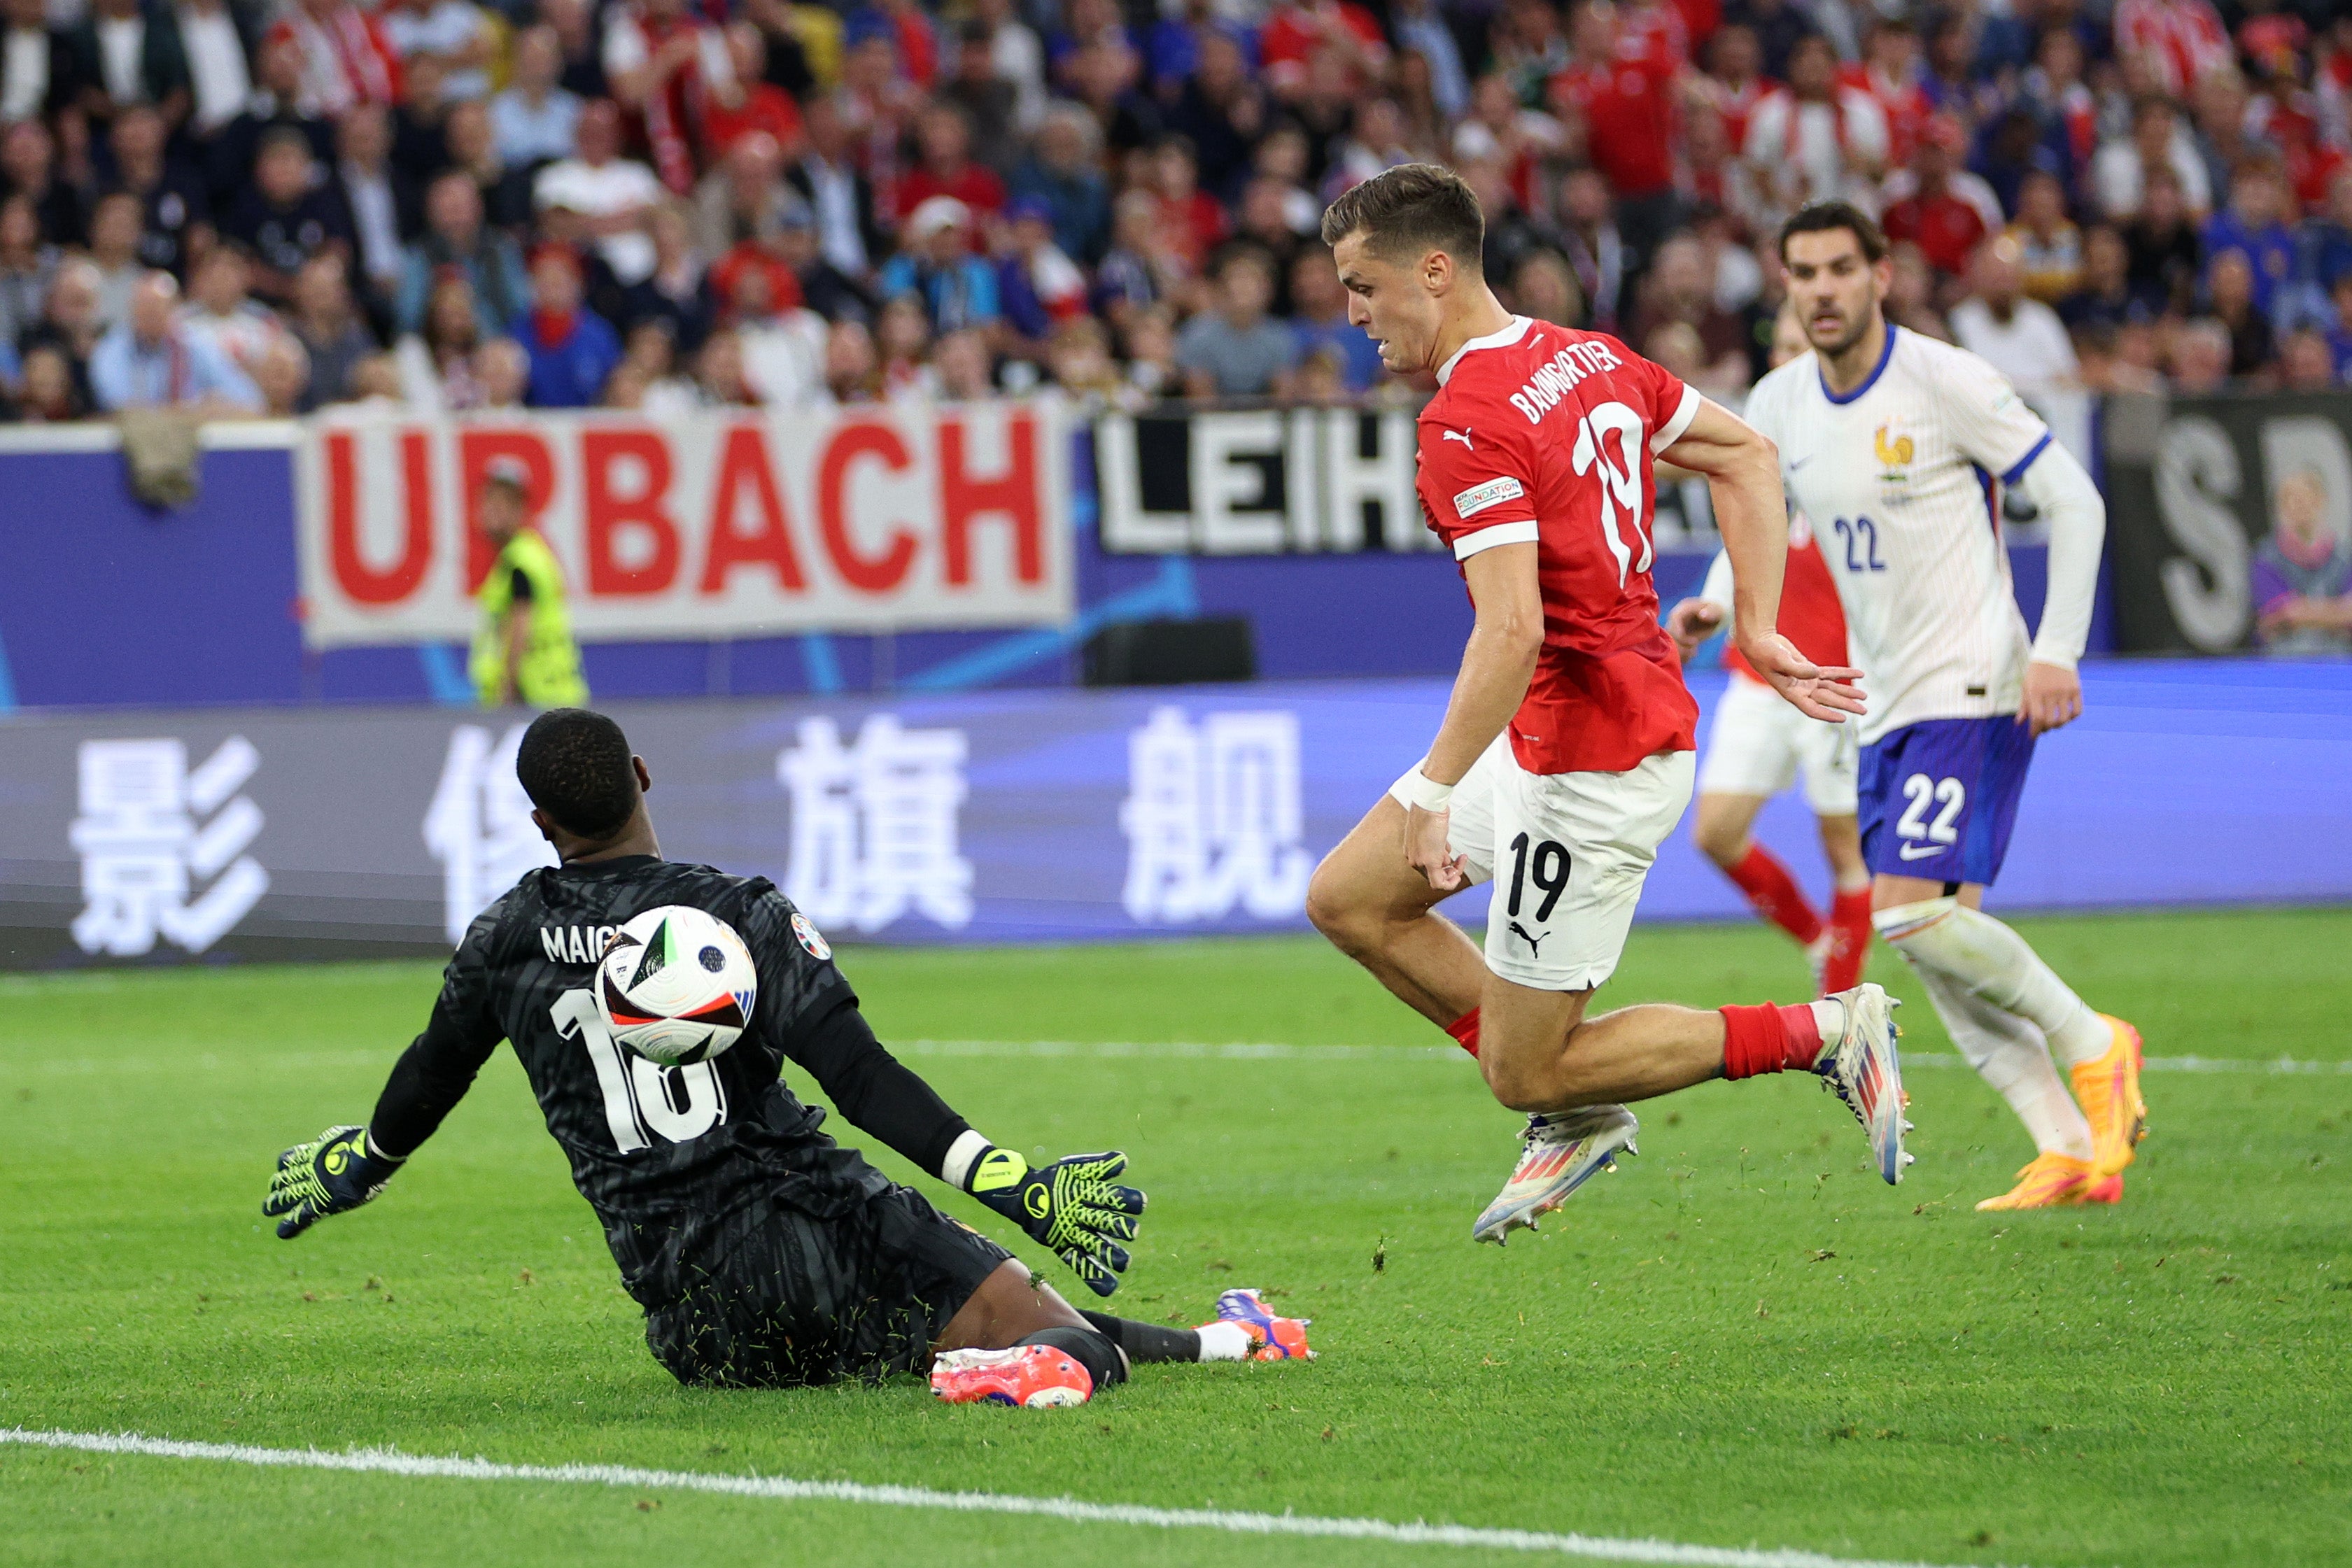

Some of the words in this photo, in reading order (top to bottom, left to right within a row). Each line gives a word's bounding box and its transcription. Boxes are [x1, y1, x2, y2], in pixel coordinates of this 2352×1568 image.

[325, 409, 1045, 606] URBACH
[1458, 481, 1519, 510] FOUNDATION
[1571, 401, 1653, 589] 19
[1835, 516, 1886, 571] 22
[1896, 772, 1966, 845] 22
[1508, 832, 1571, 922] 19
